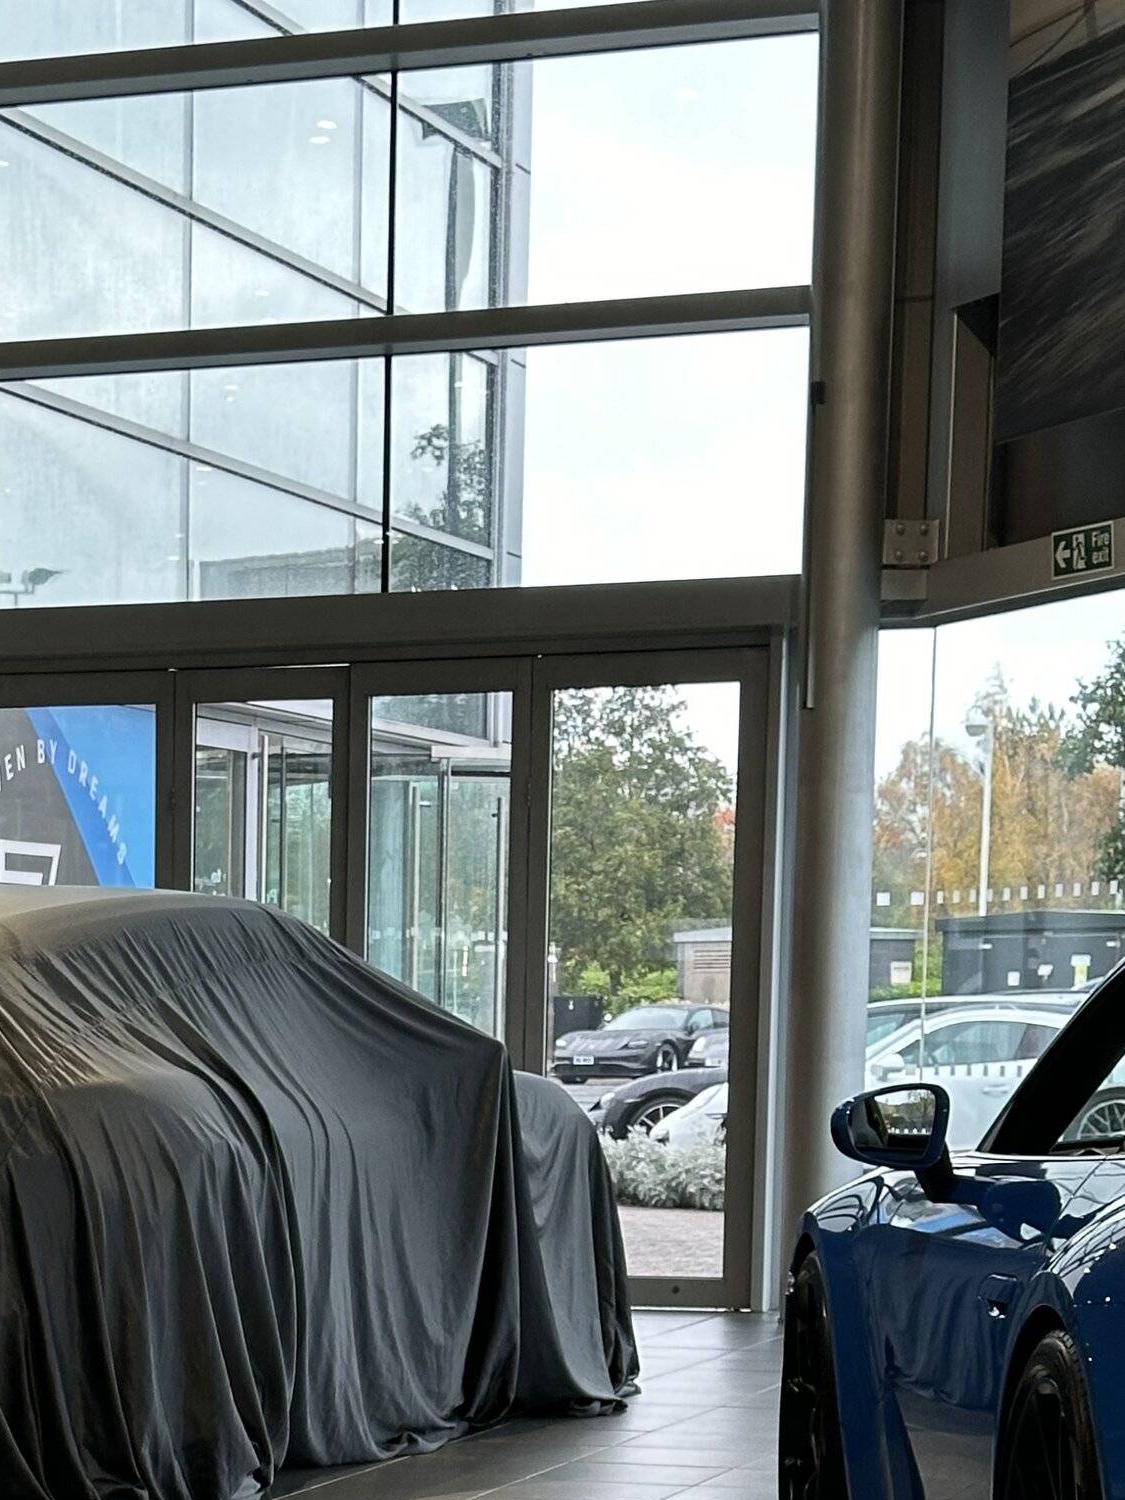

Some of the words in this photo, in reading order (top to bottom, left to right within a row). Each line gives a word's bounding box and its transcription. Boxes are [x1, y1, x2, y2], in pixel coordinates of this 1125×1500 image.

[1091, 530, 1110, 547] Fire
[1091, 546, 1110, 564] exit
[37, 739, 58, 764] BY
